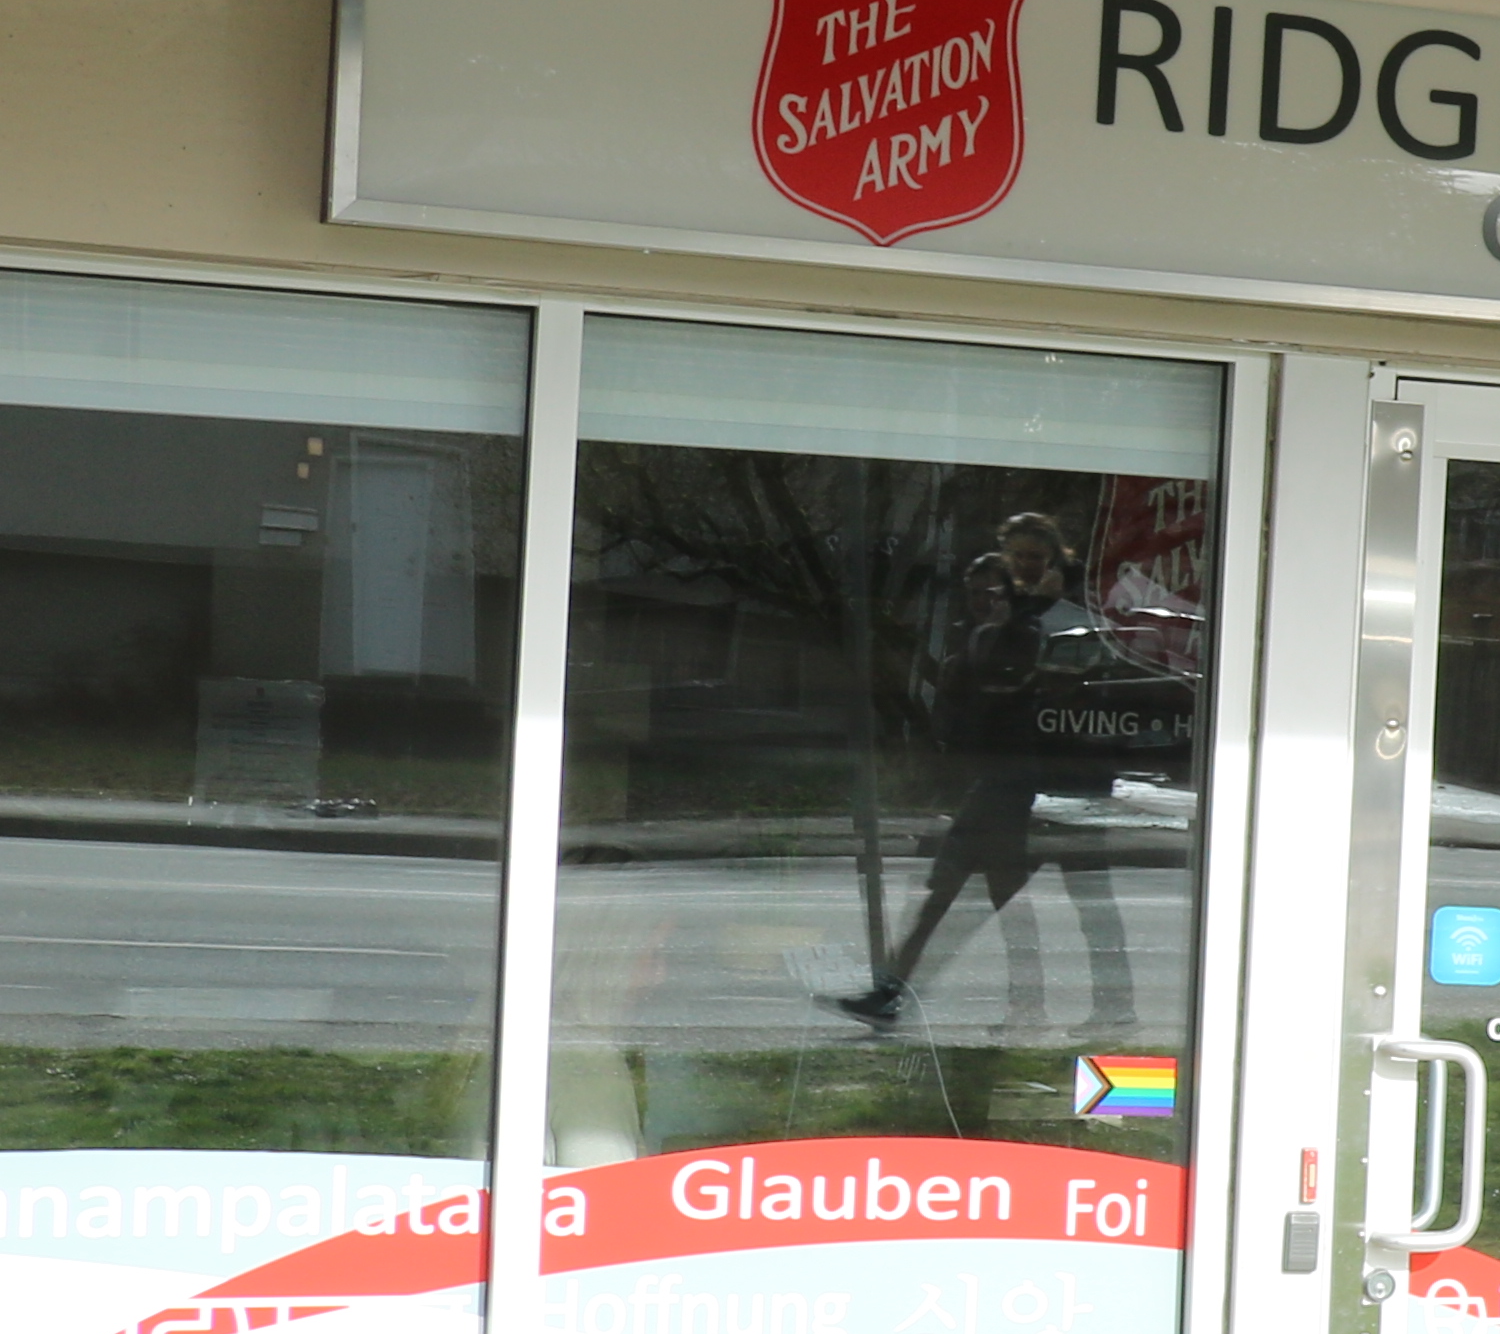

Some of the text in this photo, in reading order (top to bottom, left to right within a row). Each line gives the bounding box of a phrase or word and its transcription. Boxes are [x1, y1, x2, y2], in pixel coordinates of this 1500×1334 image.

[777, 18, 995, 154] SALVATION
[854, 94, 990, 201] ARMY
[1148, 478, 1204, 533] TH
[1037, 708, 1138, 737] GIVING
[672, 1157, 1011, 1221] Glauben
[1066, 1179, 1148, 1237] Foi
